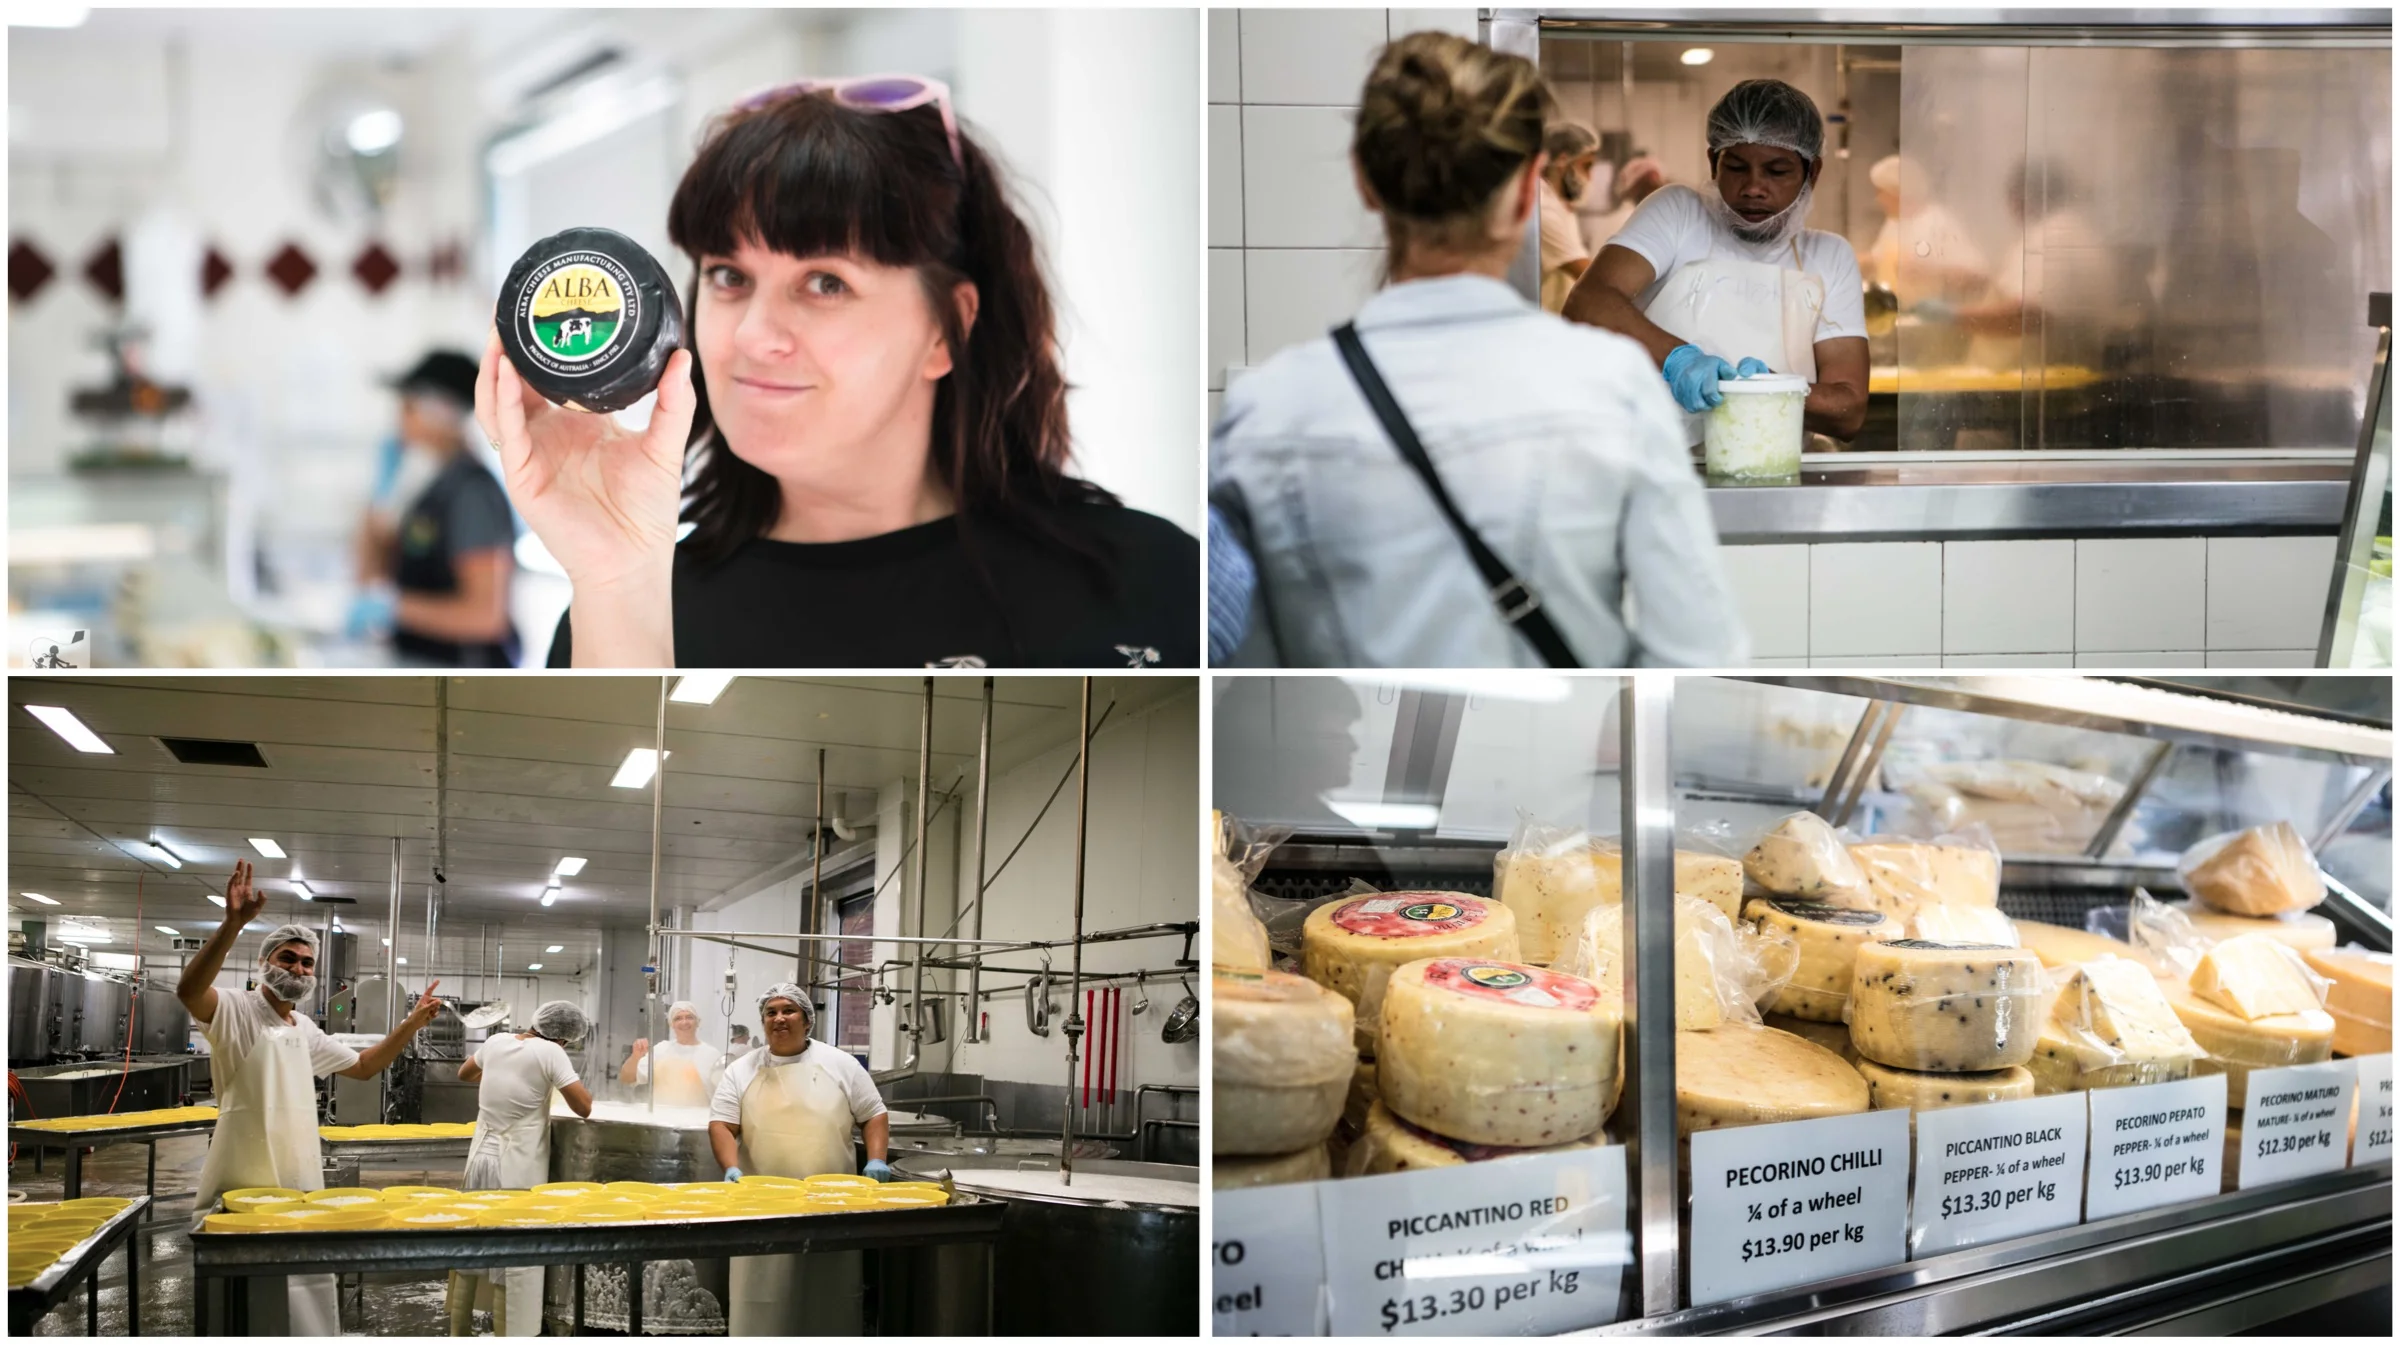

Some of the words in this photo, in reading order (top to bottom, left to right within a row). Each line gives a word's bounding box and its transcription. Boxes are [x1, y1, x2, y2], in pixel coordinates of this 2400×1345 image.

[526, 265, 552, 294] CHEESE
[553, 254, 626, 280] MANUFACTURING
[544, 277, 611, 298] ALBA
[560, 298, 592, 306] CHEESE
[622, 281, 635, 297] PTY
[519, 296, 530, 318] ALBA
[627, 298, 636, 317] LTD
[528, 344, 551, 365] PRODUCT
[2260, 1091, 2303, 1108] PECORINO
[2304, 1085, 2340, 1101] MATURO
[2115, 1112, 2167, 1132] PECORINO
[2169, 1106, 2205, 1123] PEPATO
[2300, 1111, 2309, 1122] of
[2315, 1107, 2336, 1119] wheel
[1946, 1133, 2022, 1157] PICCANTINO
[2025, 1127, 2062, 1145] BLACK
[2113, 1139, 2152, 1156] PEPPER-
[2163, 1134, 2174, 1147] of
[2175, 1136, 2181, 1145] a
[2182, 1128, 2210, 1144] wheel
[2258, 1135, 2296, 1158] $12.30
[2298, 1133, 2316, 1152] per
[2318, 1129, 2331, 1147] kg
[1726, 1157, 1825, 1188] PECORINO
[1830, 1148, 1882, 1173] CHILLI
[1944, 1166, 1993, 1185] PEPPER-
[2008, 1159, 2021, 1174] of
[2022, 1161, 2029, 1172] a
[2032, 1152, 2065, 1169] wheel
[2114, 1163, 2161, 1190] $13.90
[2164, 1161, 2187, 1182] per
[2190, 1156, 2205, 1175] kg
[1768, 1198, 1788, 1219] of
[1792, 1200, 1802, 1215] a
[1808, 1186, 1862, 1212] wheel
[1941, 1189, 2001, 1220] $13.30
[2005, 1186, 2033, 1210] per
[2037, 1180, 2056, 1201] kg
[1388, 1203, 1523, 1240] PICCANTINO
[1530, 1196, 1569, 1217] RED
[1742, 1232, 1805, 1262] $13.90
[1810, 1229, 1839, 1252] per
[1844, 1223, 1864, 1243] kg
[1213, 1284, 1262, 1315] eel
[1380, 1286, 1485, 1332] $13.30
[1494, 1278, 1541, 1310] per
[1549, 1269, 1579, 1294] kg
